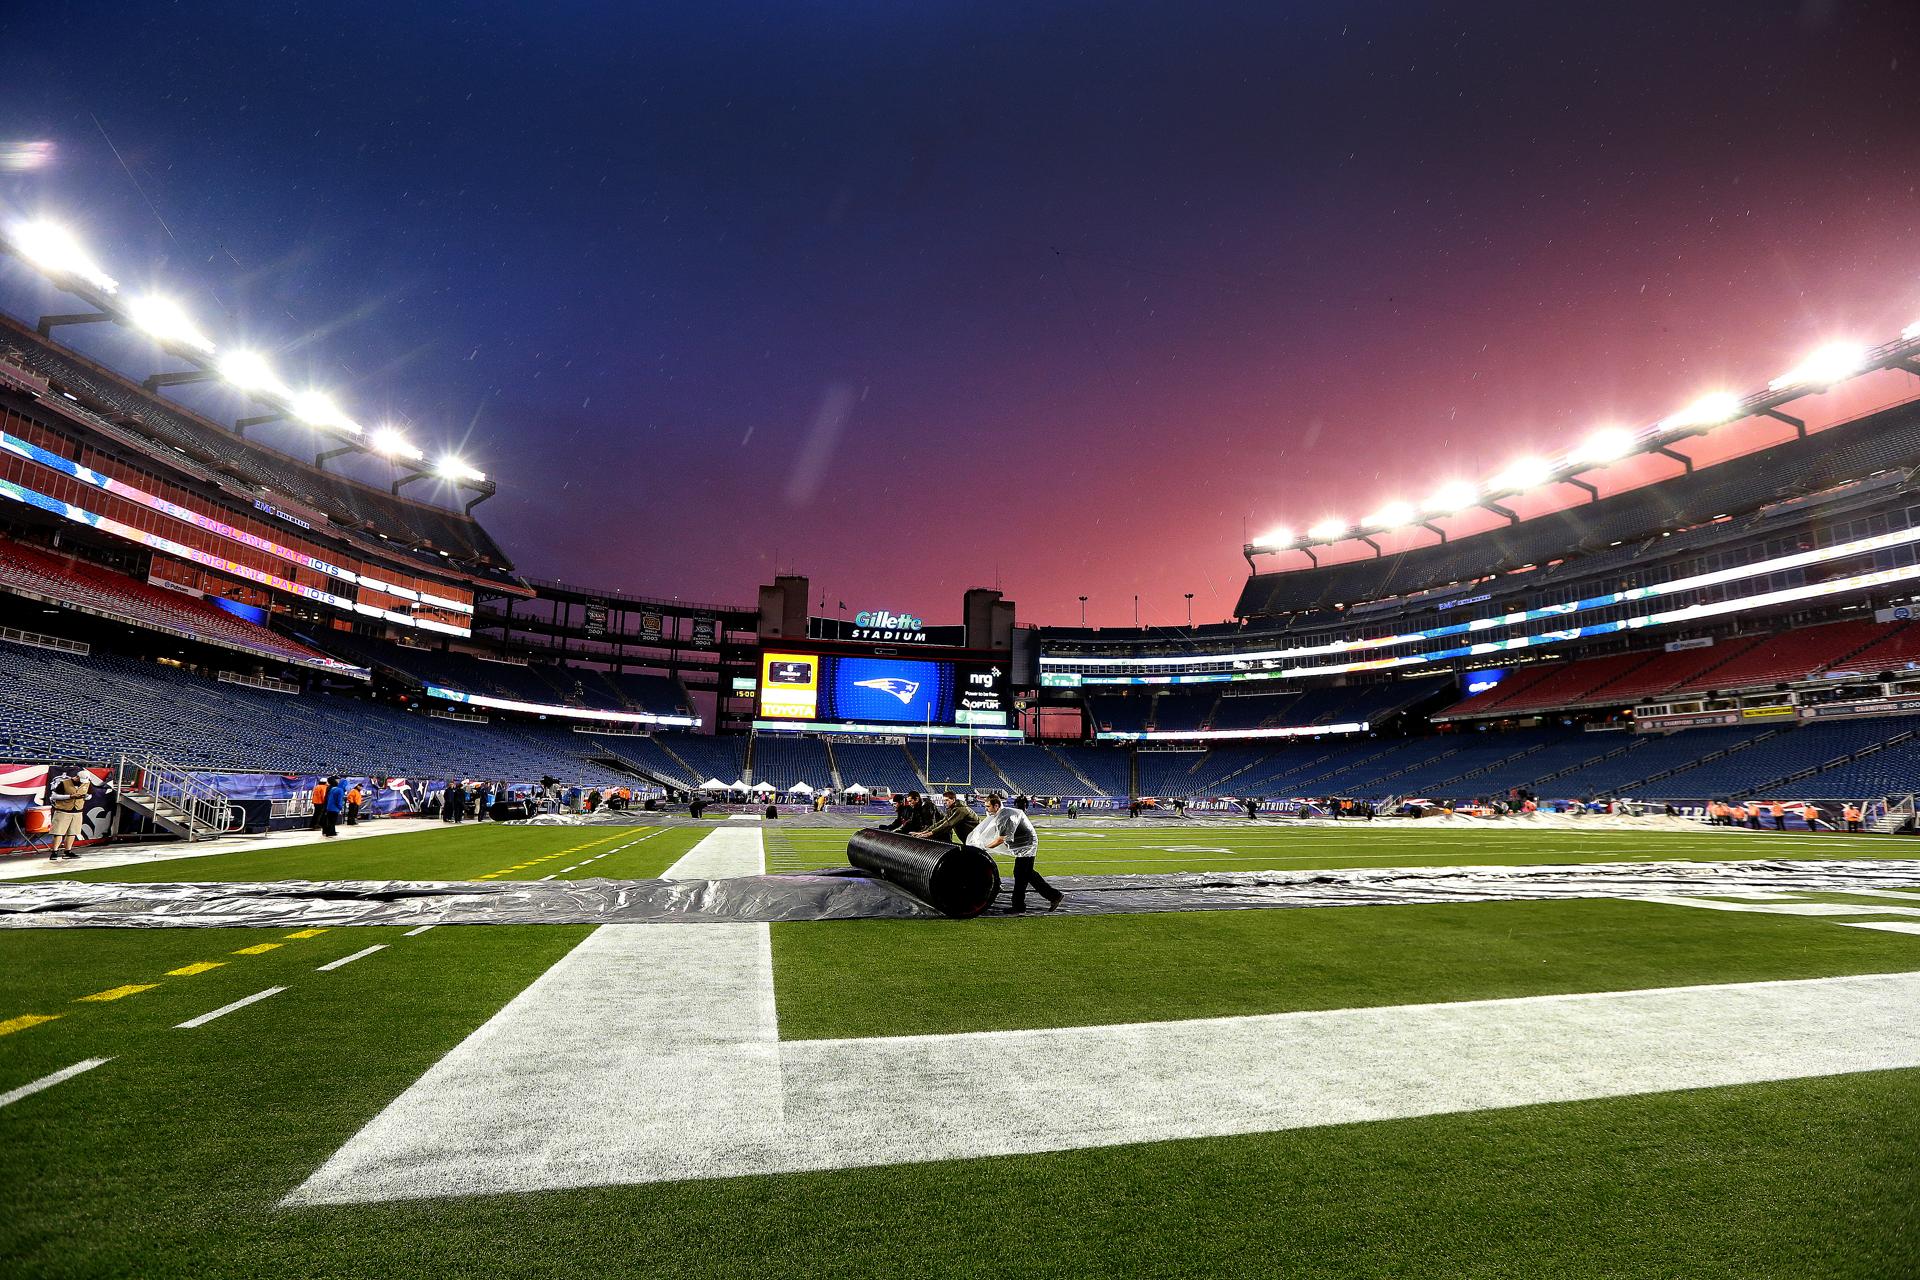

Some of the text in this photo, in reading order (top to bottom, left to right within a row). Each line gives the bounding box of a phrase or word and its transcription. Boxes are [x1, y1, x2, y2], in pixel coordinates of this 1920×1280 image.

[198, 516, 272, 550] ENGLAND
[275, 545, 339, 576] PATRIOTS
[191, 550, 266, 582] ENGLAND
[271, 576, 335, 604] PATRIOTS
[855, 610, 923, 631] Gillette
[851, 629, 926, 642] STADIUM
[969, 673, 993, 688] nrg
[765, 703, 813, 717] TOYOTA
[971, 701, 999, 709] OPTUM
[1196, 801, 1229, 810] ENGLAND
